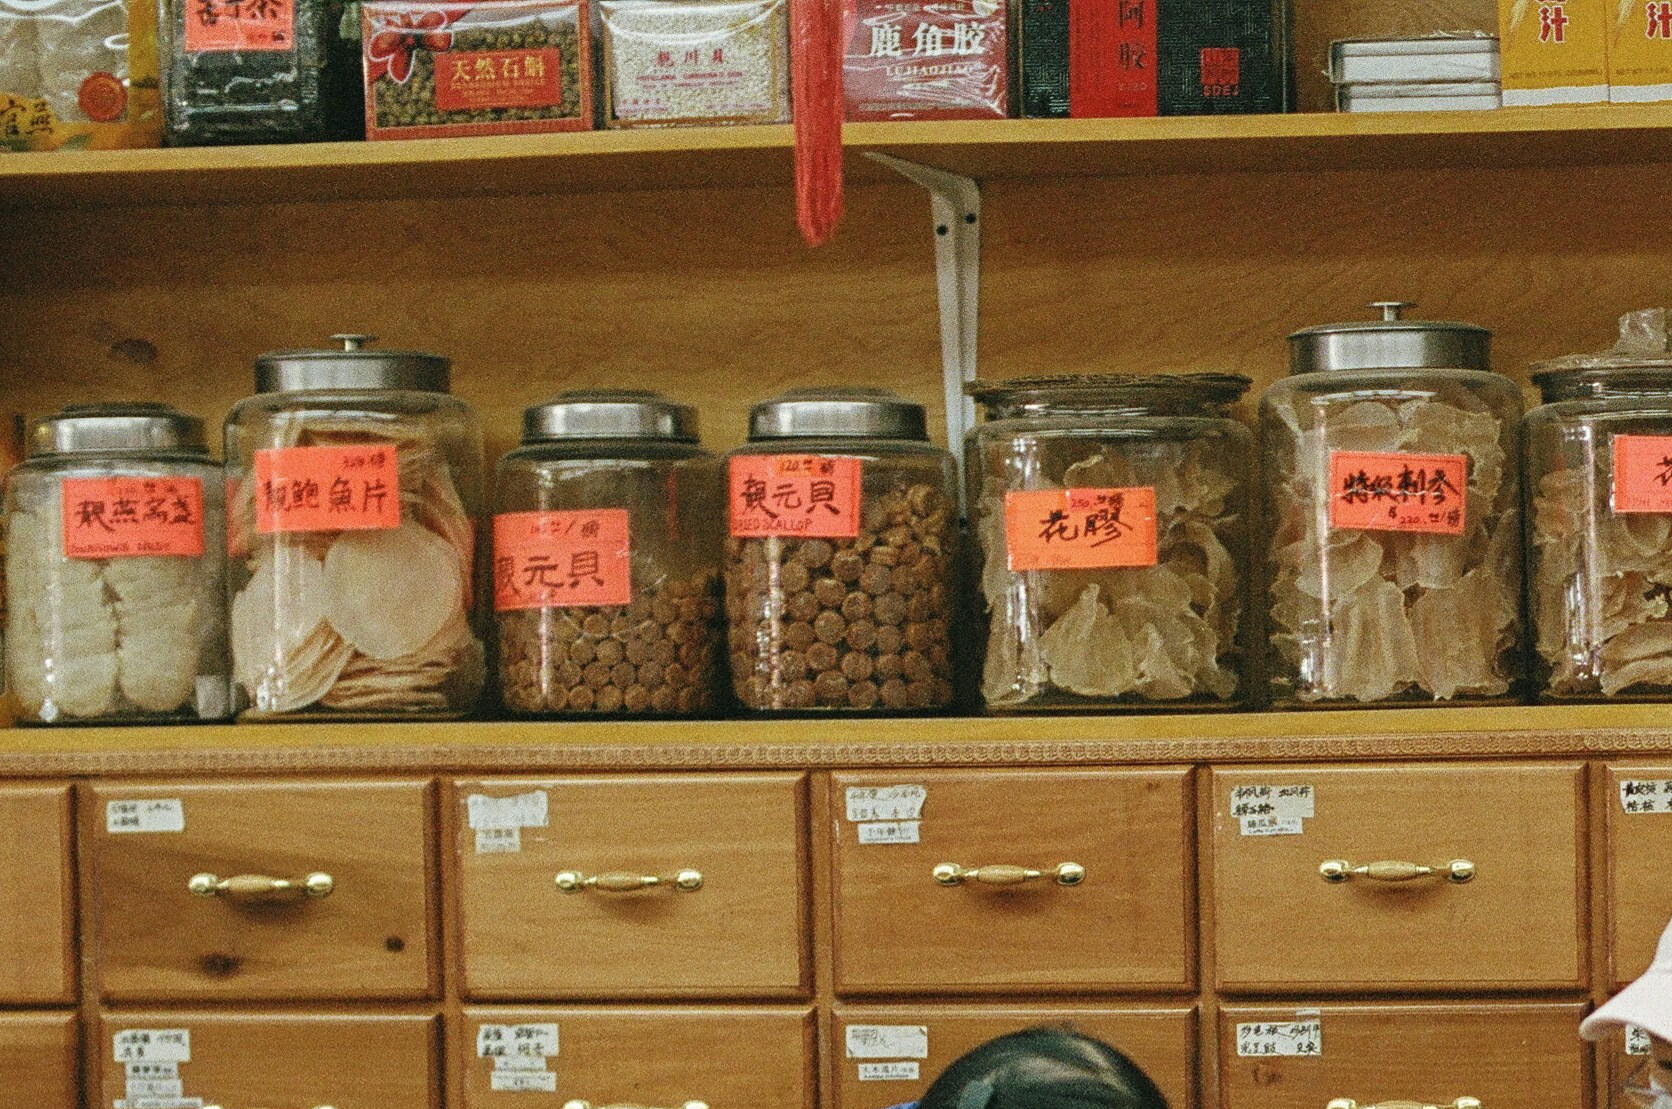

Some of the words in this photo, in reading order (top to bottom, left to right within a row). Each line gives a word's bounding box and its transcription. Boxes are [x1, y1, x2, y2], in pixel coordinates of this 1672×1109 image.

[1537, 0, 1568, 42] 汁
[452, 54, 546, 82] 天然石斛
[1038, 509, 1132, 548] 花膠
